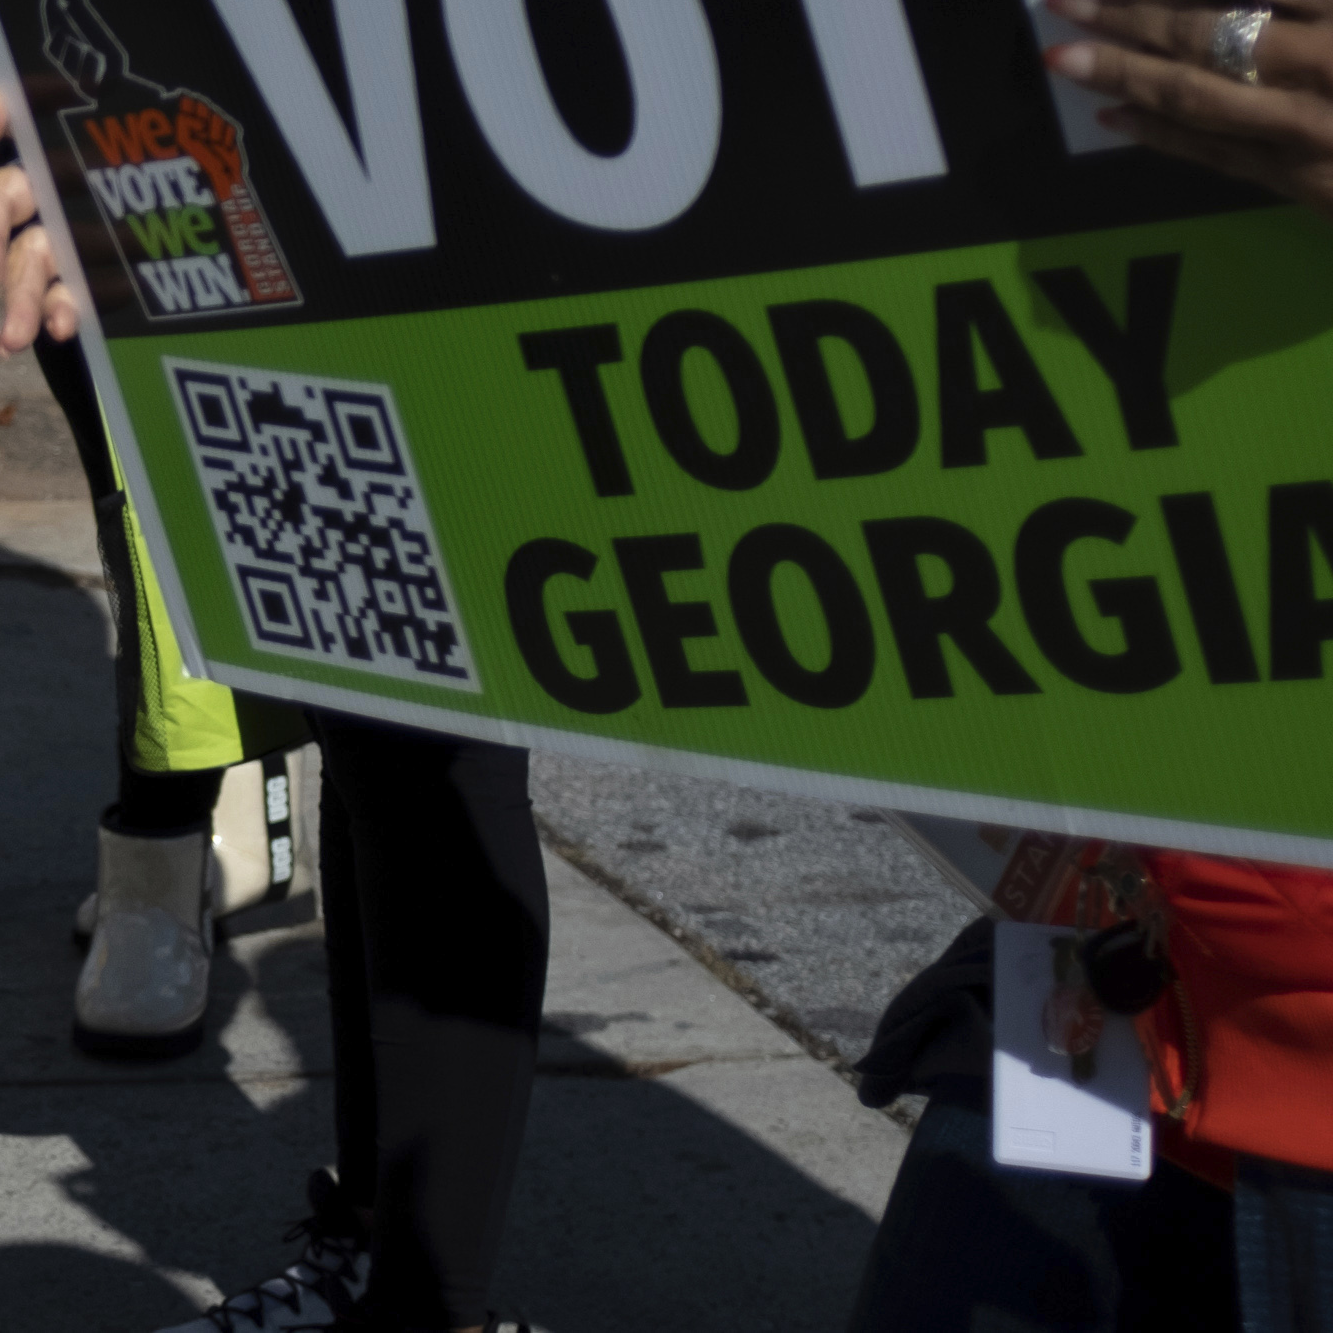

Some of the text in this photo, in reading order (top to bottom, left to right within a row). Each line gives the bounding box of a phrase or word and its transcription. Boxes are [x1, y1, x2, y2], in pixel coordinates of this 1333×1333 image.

[85, 108, 180, 166] we
[87, 155, 216, 220] VOTE
[125, 203, 221, 260] we
[516, 251, 1185, 499] TODAY
